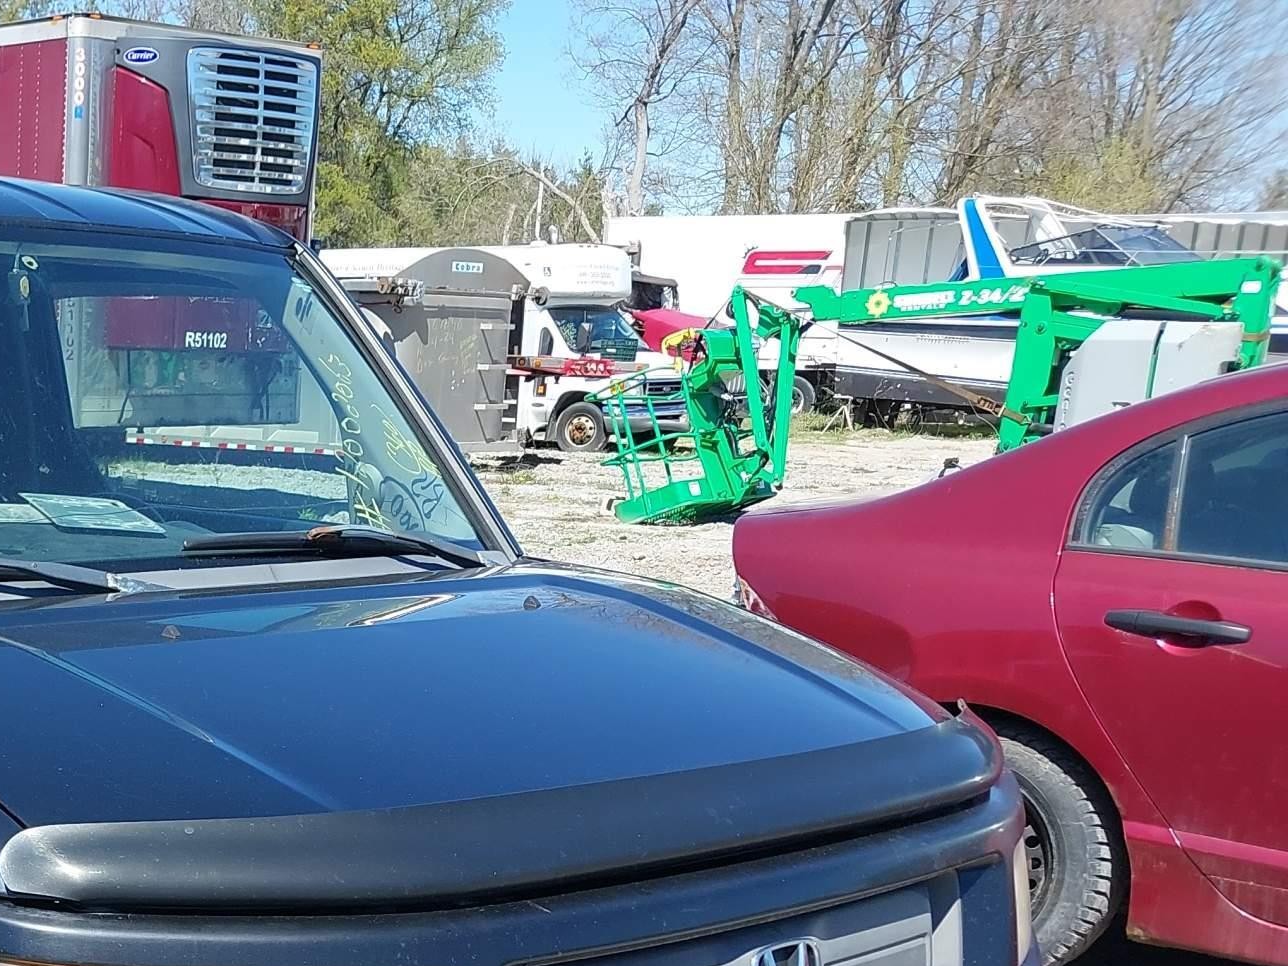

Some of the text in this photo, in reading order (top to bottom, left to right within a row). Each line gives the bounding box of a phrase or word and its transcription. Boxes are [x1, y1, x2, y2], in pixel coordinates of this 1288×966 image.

[127, 51, 154, 60] Carrier
[455, 261, 481, 272] Cobra
[185, 331, 227, 349] R51102
